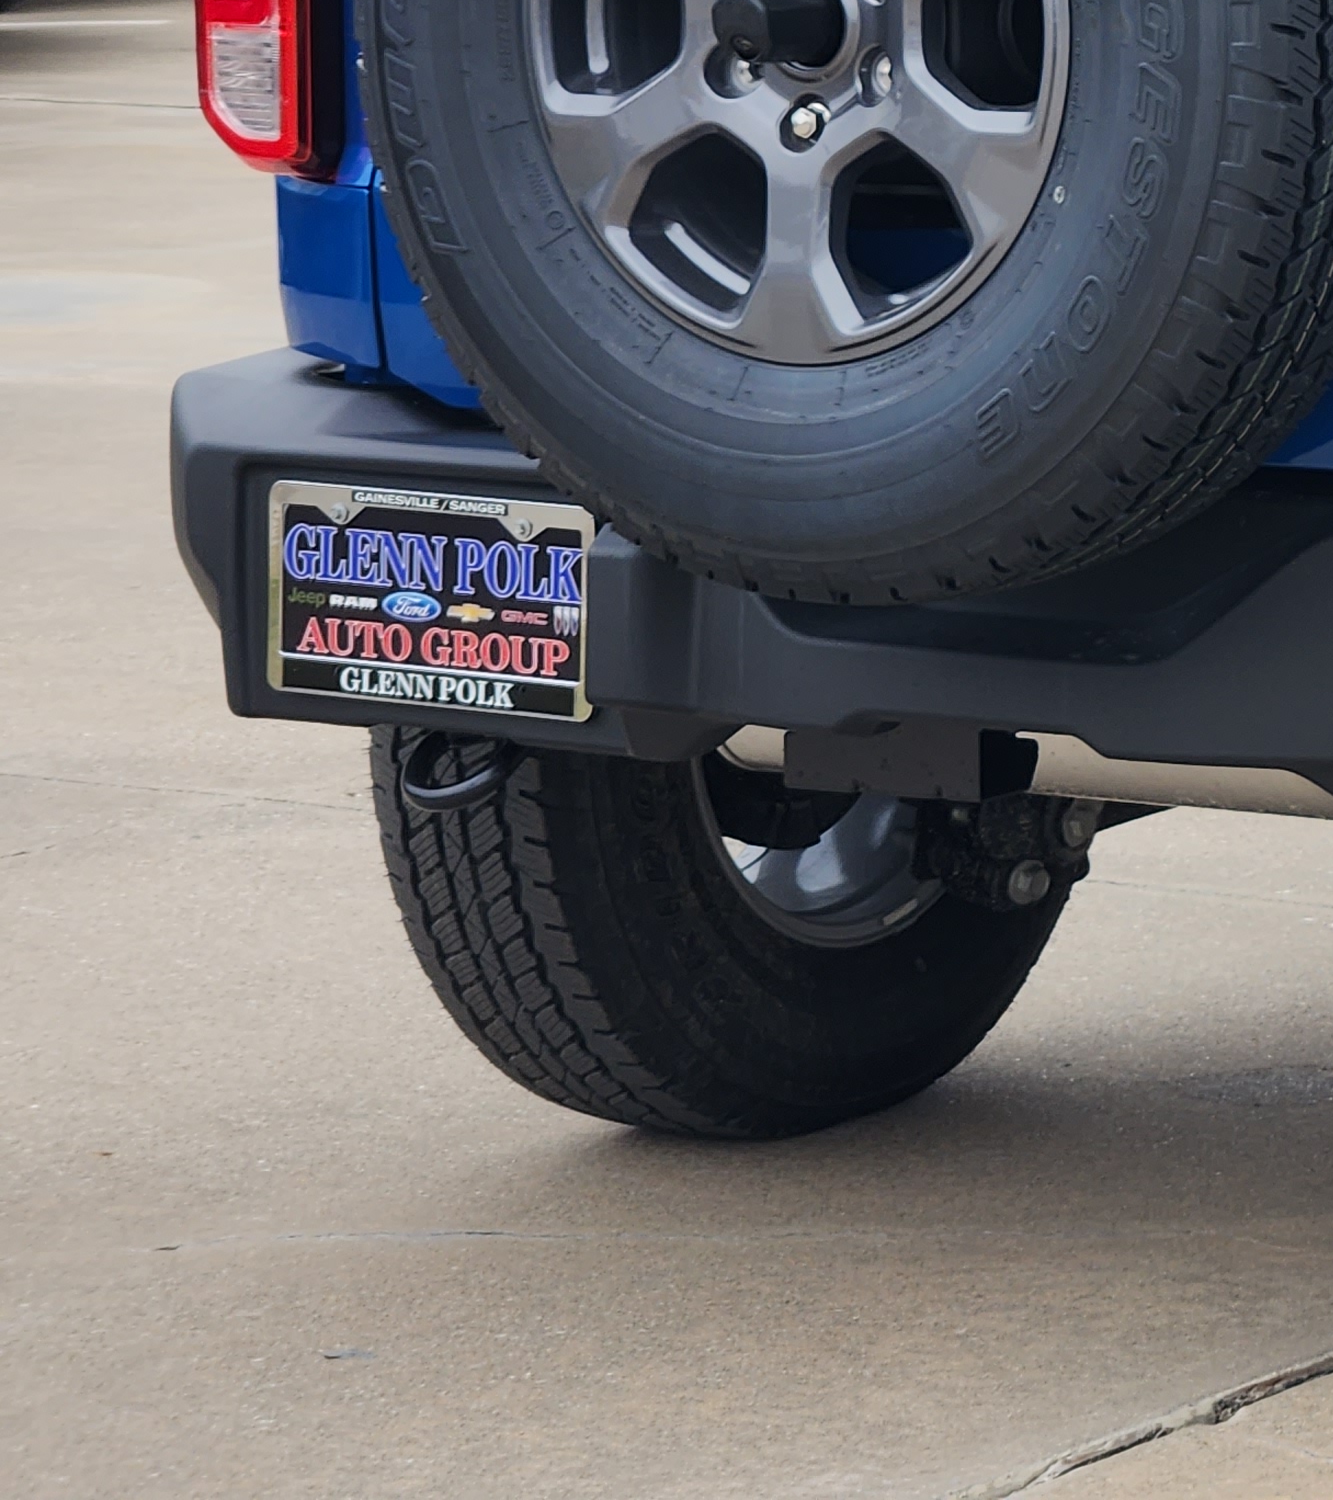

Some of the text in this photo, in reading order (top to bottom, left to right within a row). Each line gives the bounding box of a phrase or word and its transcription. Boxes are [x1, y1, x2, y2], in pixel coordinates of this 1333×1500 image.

[354, 491, 440, 510] GAINESVILLE
[449, 500, 506, 515] SANGER
[284, 522, 584, 604] GLENN POLK
[288, 588, 326, 608] Jeep
[329, 593, 378, 611] RAM
[391, 598, 432, 619] Ford
[500, 609, 548, 626] GMC
[296, 616, 571, 677] AUTO GROUP
[339, 666, 515, 709] GLENN POLK
